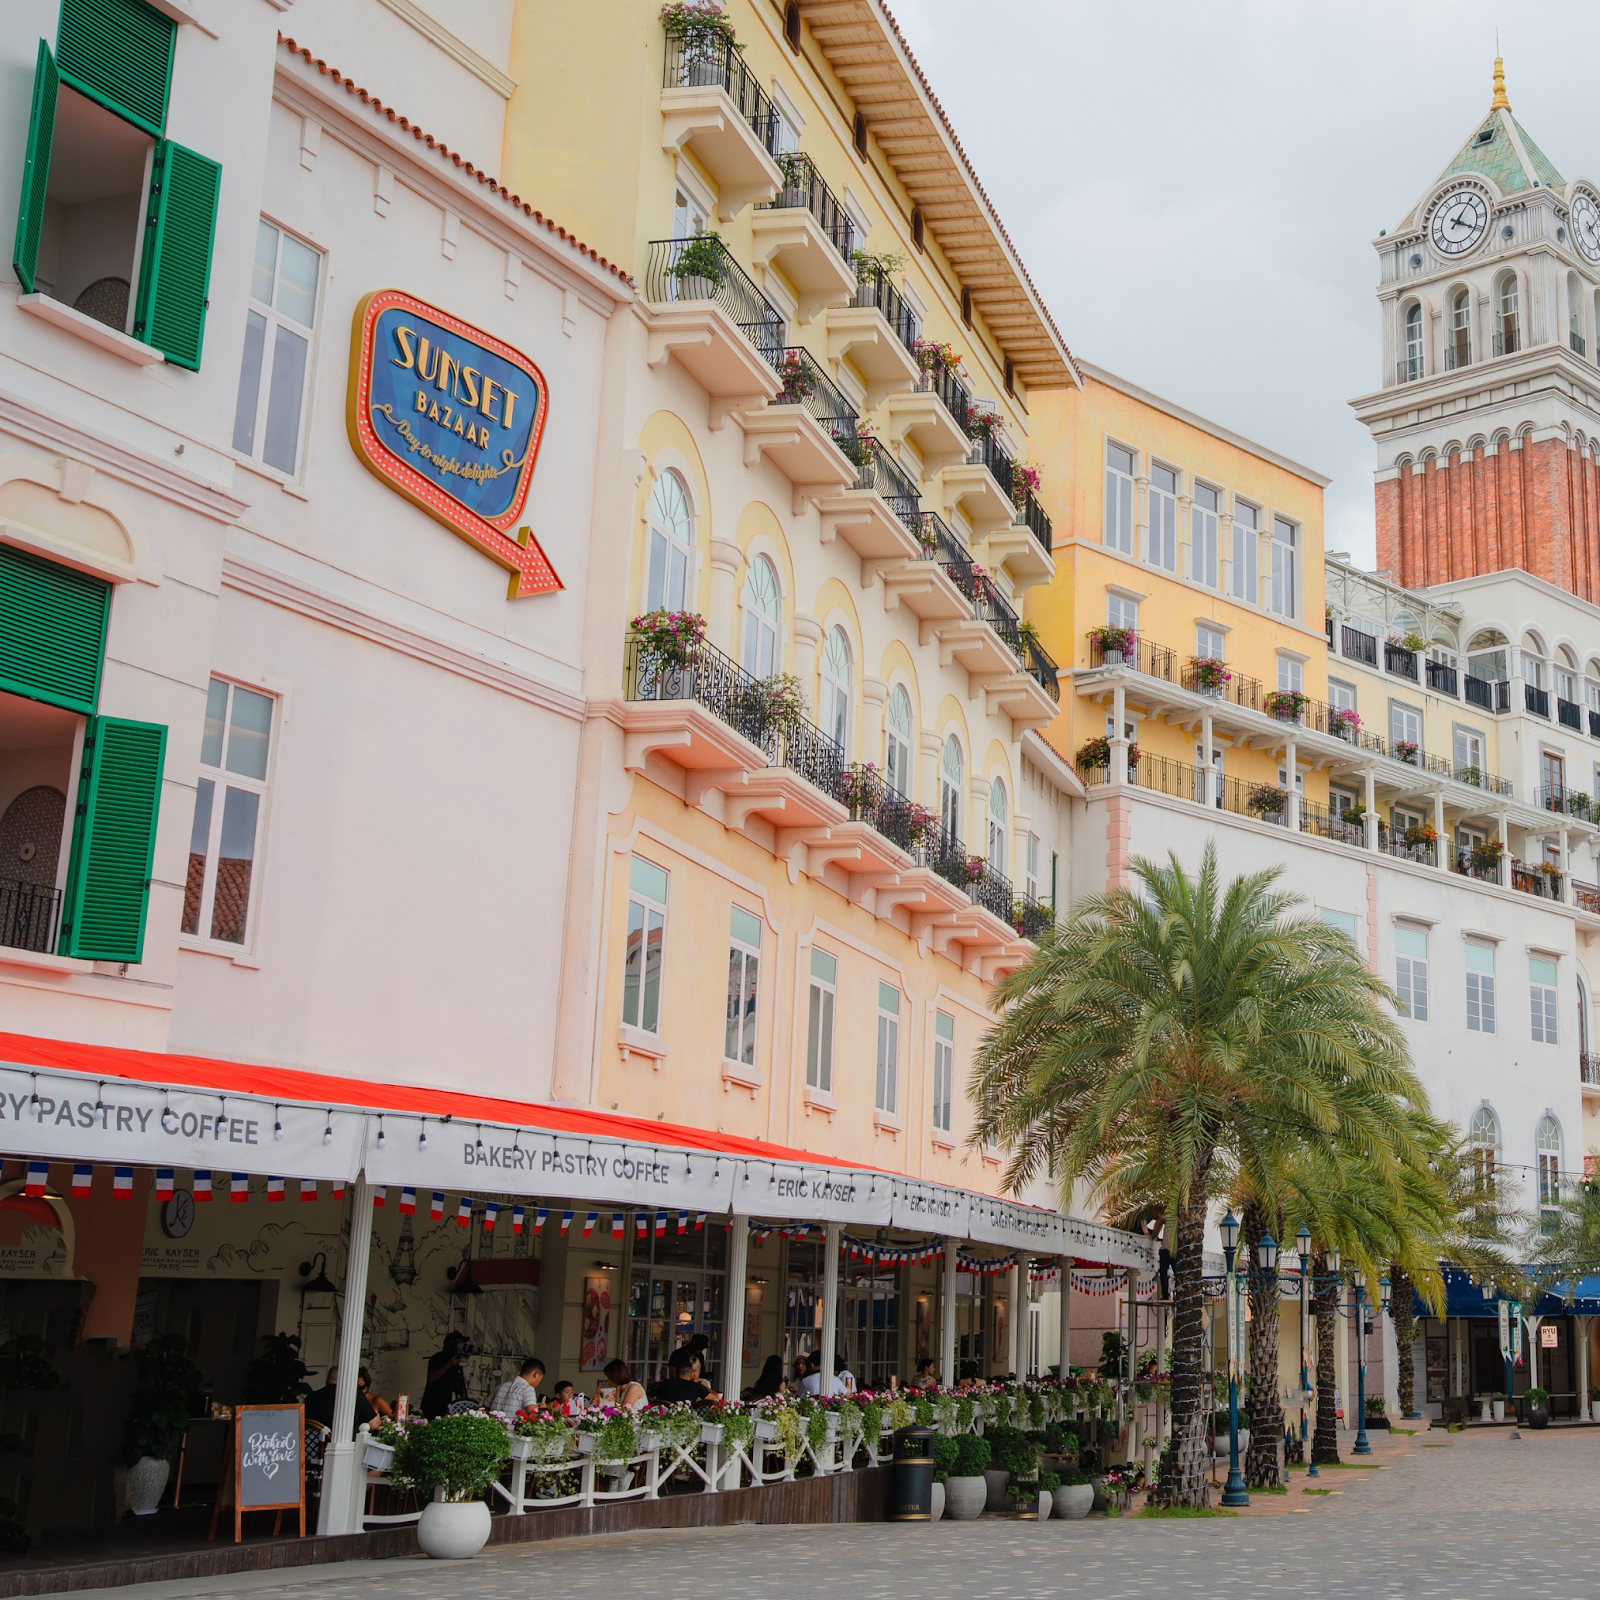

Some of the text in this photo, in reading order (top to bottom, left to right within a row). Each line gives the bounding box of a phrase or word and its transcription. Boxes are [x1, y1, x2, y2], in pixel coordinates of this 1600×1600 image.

[391, 326, 519, 430] SUNSET
[414, 390, 490, 451] BAZAAR
[396, 419, 420, 452] Day
[432, 455, 460, 475] night
[460, 461, 498, 486] delights
[37, 1097, 154, 1133] PASTRY
[161, 1111, 259, 1145] COFFEE
[463, 1143, 670, 1184] BAKERY PASTRY COFFEE
[777, 1178, 857, 1203] ERIC KAYSER
[1, 1249, 36, 1259] KAYSER
[158, 1263, 181, 1271] PARIS
[165, 1249, 200, 1258] KAYSER
[248, 1431, 296, 1456] Baked
